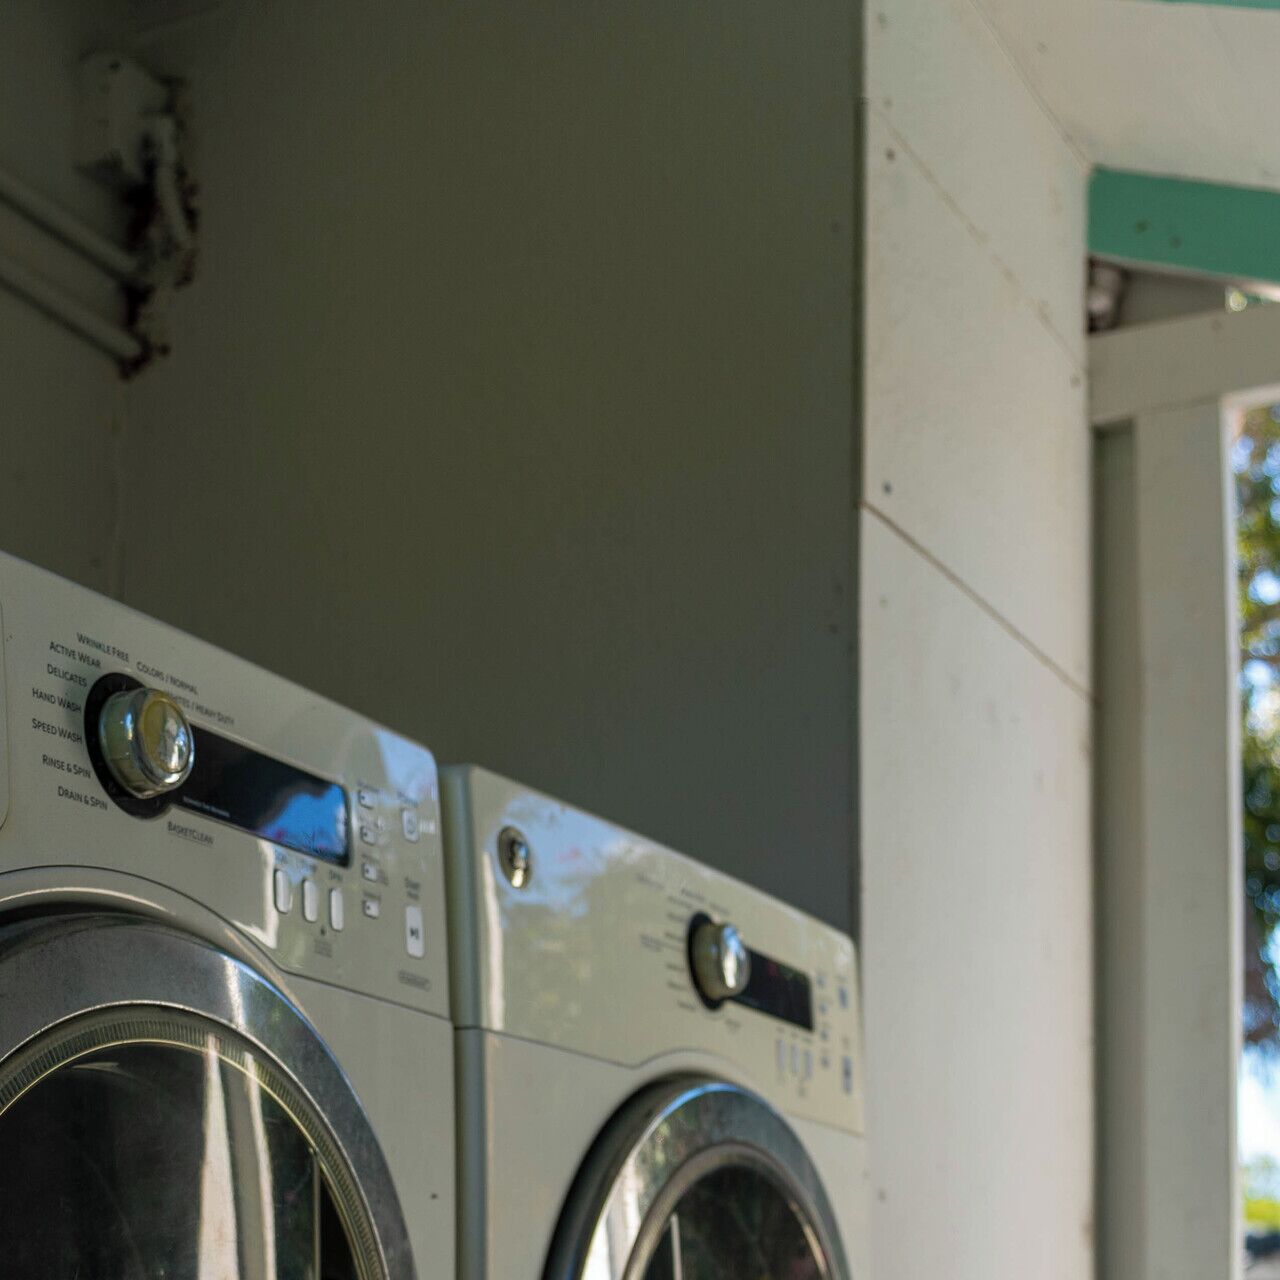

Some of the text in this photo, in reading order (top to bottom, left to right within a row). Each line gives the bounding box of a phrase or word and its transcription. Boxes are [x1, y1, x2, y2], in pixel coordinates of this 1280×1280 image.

[49, 641, 102, 669] ACTIVE WEAR
[77, 632, 130, 664] WRINKLE FREE
[47, 663, 88, 688] DELICATES
[32, 687, 82, 713] HAND WASH
[31, 718, 82, 745] SPEED WASH
[42, 754, 66, 772] RINSE
[73, 763, 91, 779] SPIN
[58, 785, 83, 802] DRAIN
[90, 796, 108, 811] SPIN
